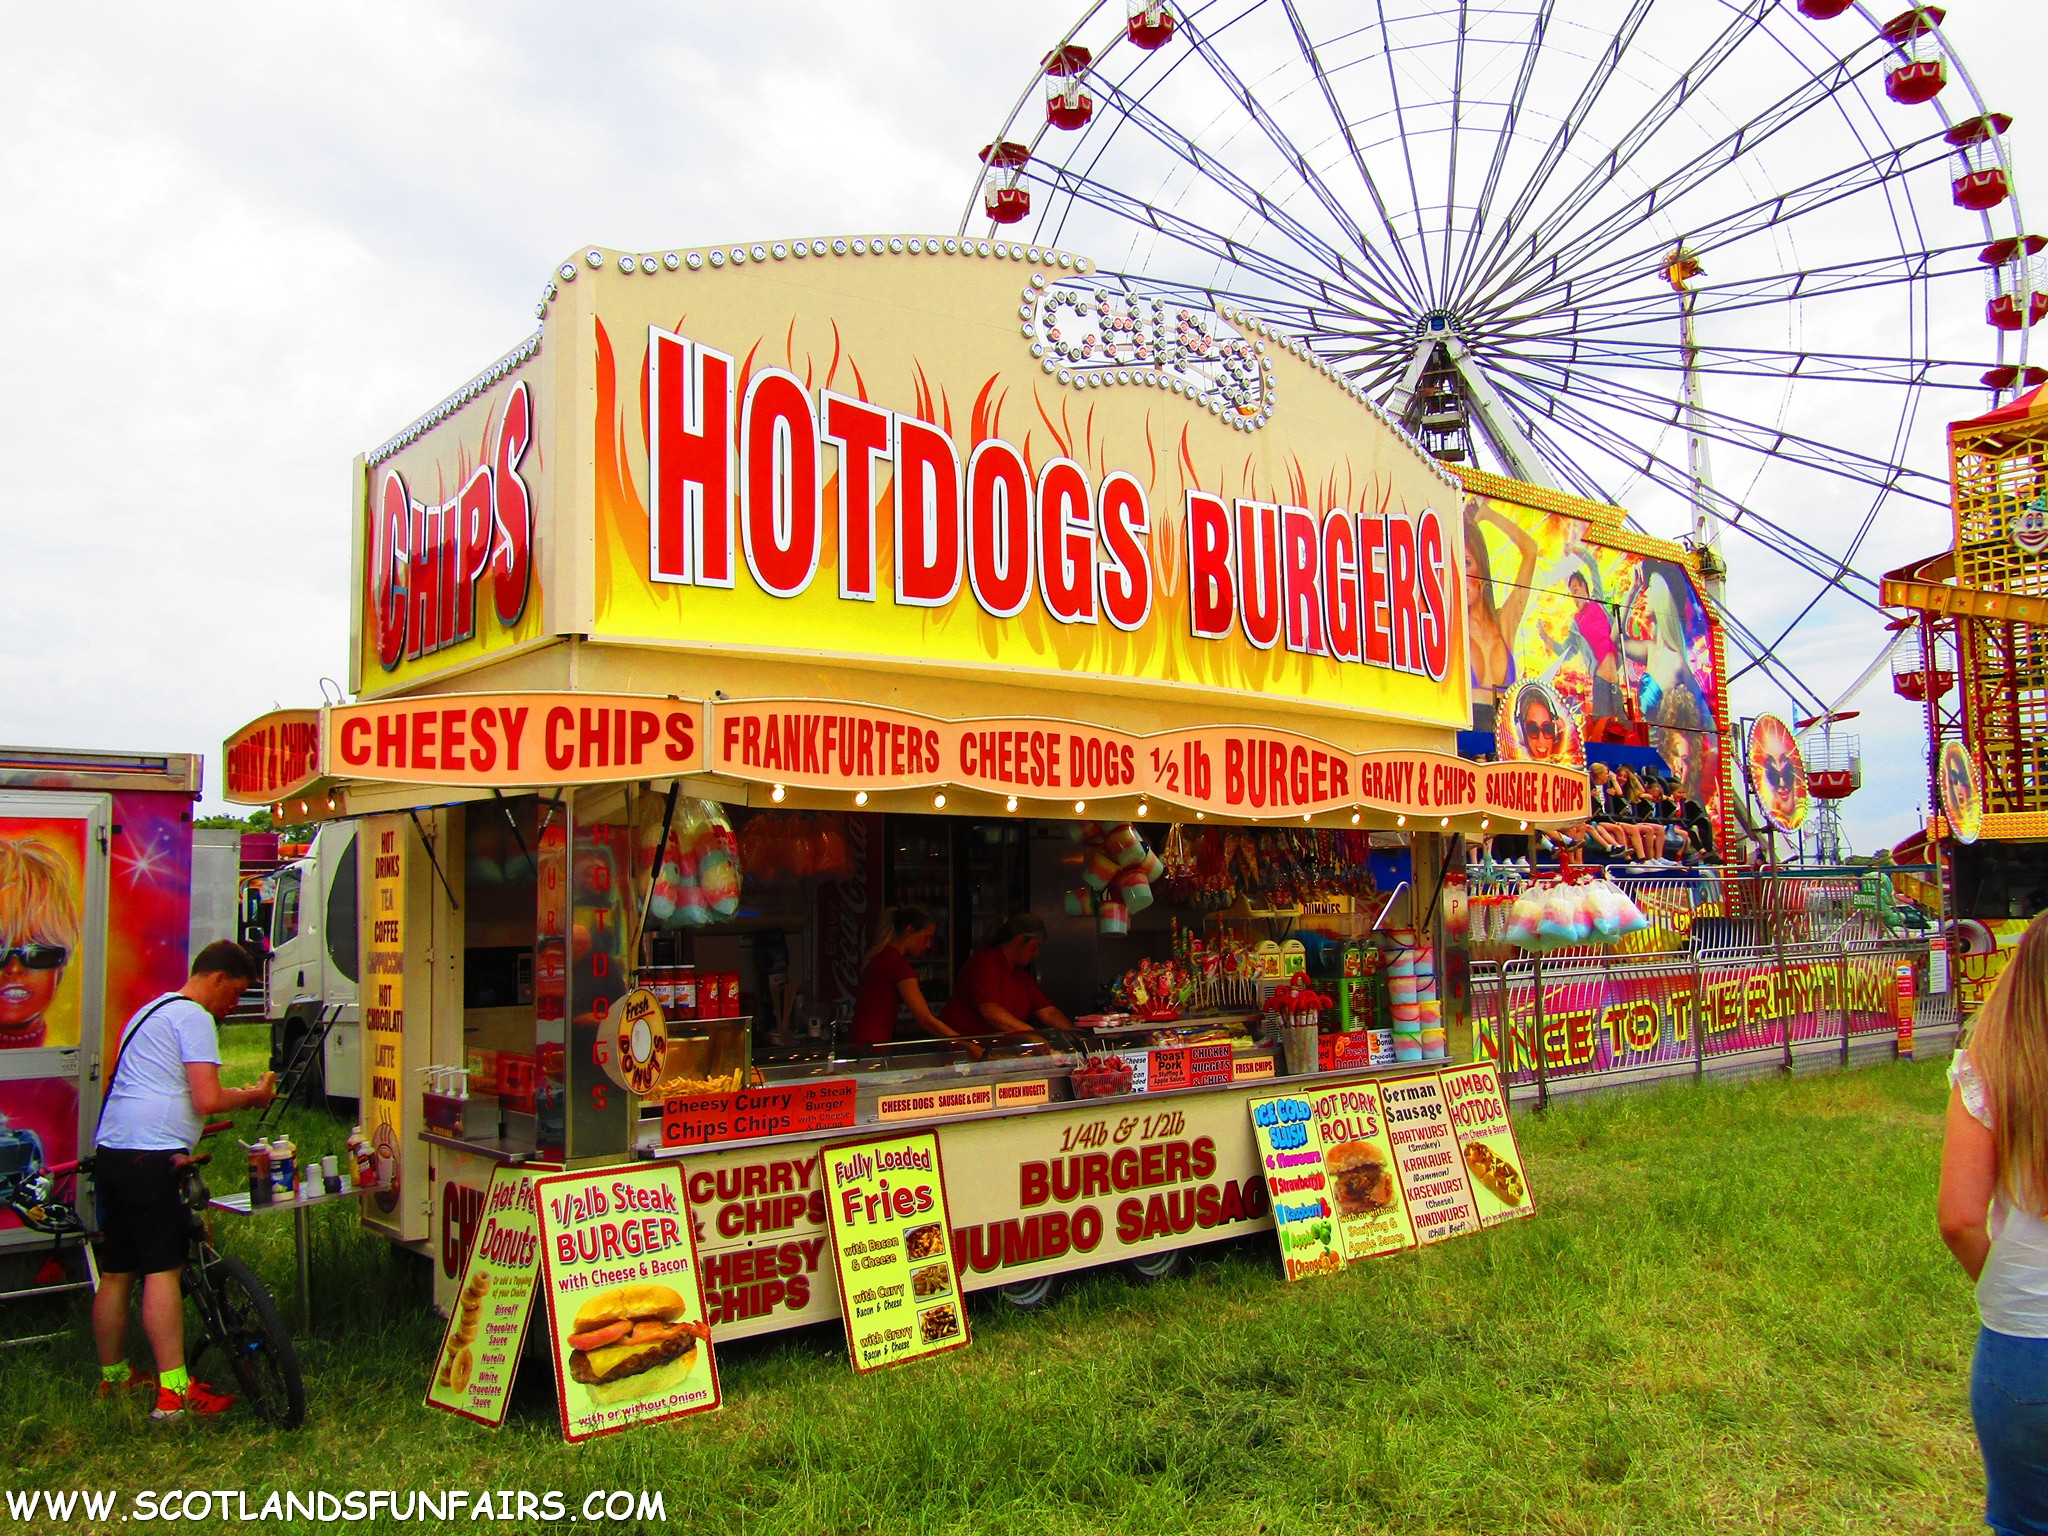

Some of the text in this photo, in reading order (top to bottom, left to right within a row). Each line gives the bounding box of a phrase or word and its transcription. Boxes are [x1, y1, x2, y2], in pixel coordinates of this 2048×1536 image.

[648, 324, 1450, 682] HOTDOGS BURGERS
[377, 379, 532, 674] CHIPS
[340, 706, 695, 772] CHEESY CHIPS
[723, 713, 940, 777] FRANKFURTERS
[281, 722, 319, 787] CHIPS
[959, 730, 1135, 788] CHEESE DOGS
[1225, 738, 1350, 808] BURGER
[1361, 760, 1477, 807] GRAVY & CHIPS
[1485, 772, 1584, 814] SAUSAGE & CHIPS
[381, 830, 394, 854] HOT
[375, 854, 400, 879] DRINKS
[380, 888, 394, 911] TEA
[374, 920, 399, 943] COFFEE
[379, 984, 392, 1007] HOT
[626, 995, 650, 1021] Fresh
[1601, 999, 1661, 1057] TO
[374, 1045, 395, 1069] LATTE
[1155, 1050, 1185, 1062] Roast
[1191, 1047, 1230, 1059] CHICKEN
[1157, 1061, 1182, 1073] Pork
[1191, 1060, 1230, 1073] NUGGETS
[1235, 1061, 1273, 1074] FRESH CHIPS
[372, 1074, 396, 1103] MOCHA
[998, 1083, 1046, 1100] CHICKEN NUGGETS
[1202, 1074, 1228, 1086] CHIPS
[1445, 1072, 1496, 1105] JUMBO
[735, 1093, 793, 1111] Curry
[820, 1086, 853, 1099] Steak
[938, 1093, 966, 1108] SAUSAGE
[972, 1091, 991, 1104] CHIPS
[1338, 1089, 1380, 1117] PORK
[1382, 1083, 1437, 1104] German
[666, 1097, 729, 1115] Cheesy
[805, 1098, 844, 1113] Burger
[819, 1111, 851, 1121] Cheese
[881, 1096, 935, 1114] CHEESE DOGS
[1253, 1098, 1313, 1128] ICE COLD
[1385, 1102, 1443, 1123] Sausage
[1450, 1096, 1503, 1128] HOTDOG
[666, 1120, 729, 1143] Chips
[733, 1115, 791, 1135] Chips
[1059, 1110, 1186, 1153] 1/4lb & 1/2lb
[1268, 1121, 1309, 1151] SLUSH
[1319, 1114, 1380, 1144] ROLLS
[1391, 1123, 1450, 1146] BRATWURST
[1470, 1126, 1488, 1139] Cheese
[1493, 1123, 1509, 1135] Bacon
[1407, 1139, 1441, 1153] (Smokey)
[834, 1145, 932, 1188] Fully Loaded
[1276, 1150, 1322, 1169] flavours
[1402, 1151, 1454, 1173] KRAKAURE
[688, 1157, 819, 1205] CURRY
[1020, 1134, 1218, 1210] BURGERS
[1277, 1174, 1321, 1194] Strawberry
[1406, 1177, 1465, 1202] KASEWURST
[488, 1180, 516, 1215] Hot
[550, 1181, 679, 1230] 1/2lb Steak
[841, 1178, 935, 1226] Fries
[1425, 1195, 1454, 1209] (Cheese)
[715, 1189, 828, 1239] CHIPS
[1284, 1202, 1324, 1223] Raspberry
[1339, 1203, 1400, 1225] with or without
[1414, 1204, 1470, 1229] RINDWURST
[1346, 1216, 1398, 1238] Stuffing &
[479, 1217, 538, 1269] Donuts
[555, 1216, 683, 1267] BURGER
[843, 1236, 900, 1257] with Bacon
[1290, 1230, 1316, 1250] Apple
[1348, 1232, 1405, 1254] Apple Sauce
[701, 1237, 828, 1290] HEESY
[851, 1253, 897, 1272] & Cheese
[1295, 1257, 1323, 1277] Orange
[558, 1257, 689, 1293] with Cheese & Bacon
[705, 1274, 811, 1328] CHIPS
[852, 1283, 905, 1305] with Curry
[494, 1304, 519, 1318] Biscoff
[856, 1298, 903, 1319] Bacon & Cheese
[485, 1322, 519, 1334] Chocolate
[860, 1325, 913, 1349] with Gravy
[488, 1335, 508, 1346] Sauce
[891, 1340, 910, 1354] Cheese
[480, 1353, 506, 1364] Nutella
[478, 1371, 499, 1383] White
[468, 1383, 502, 1396] Chocolate
[472, 1396, 492, 1408] Sauce
[578, 1411, 605, 1428] with
[621, 1397, 667, 1417] without
[668, 1388, 708, 1407] Onions
